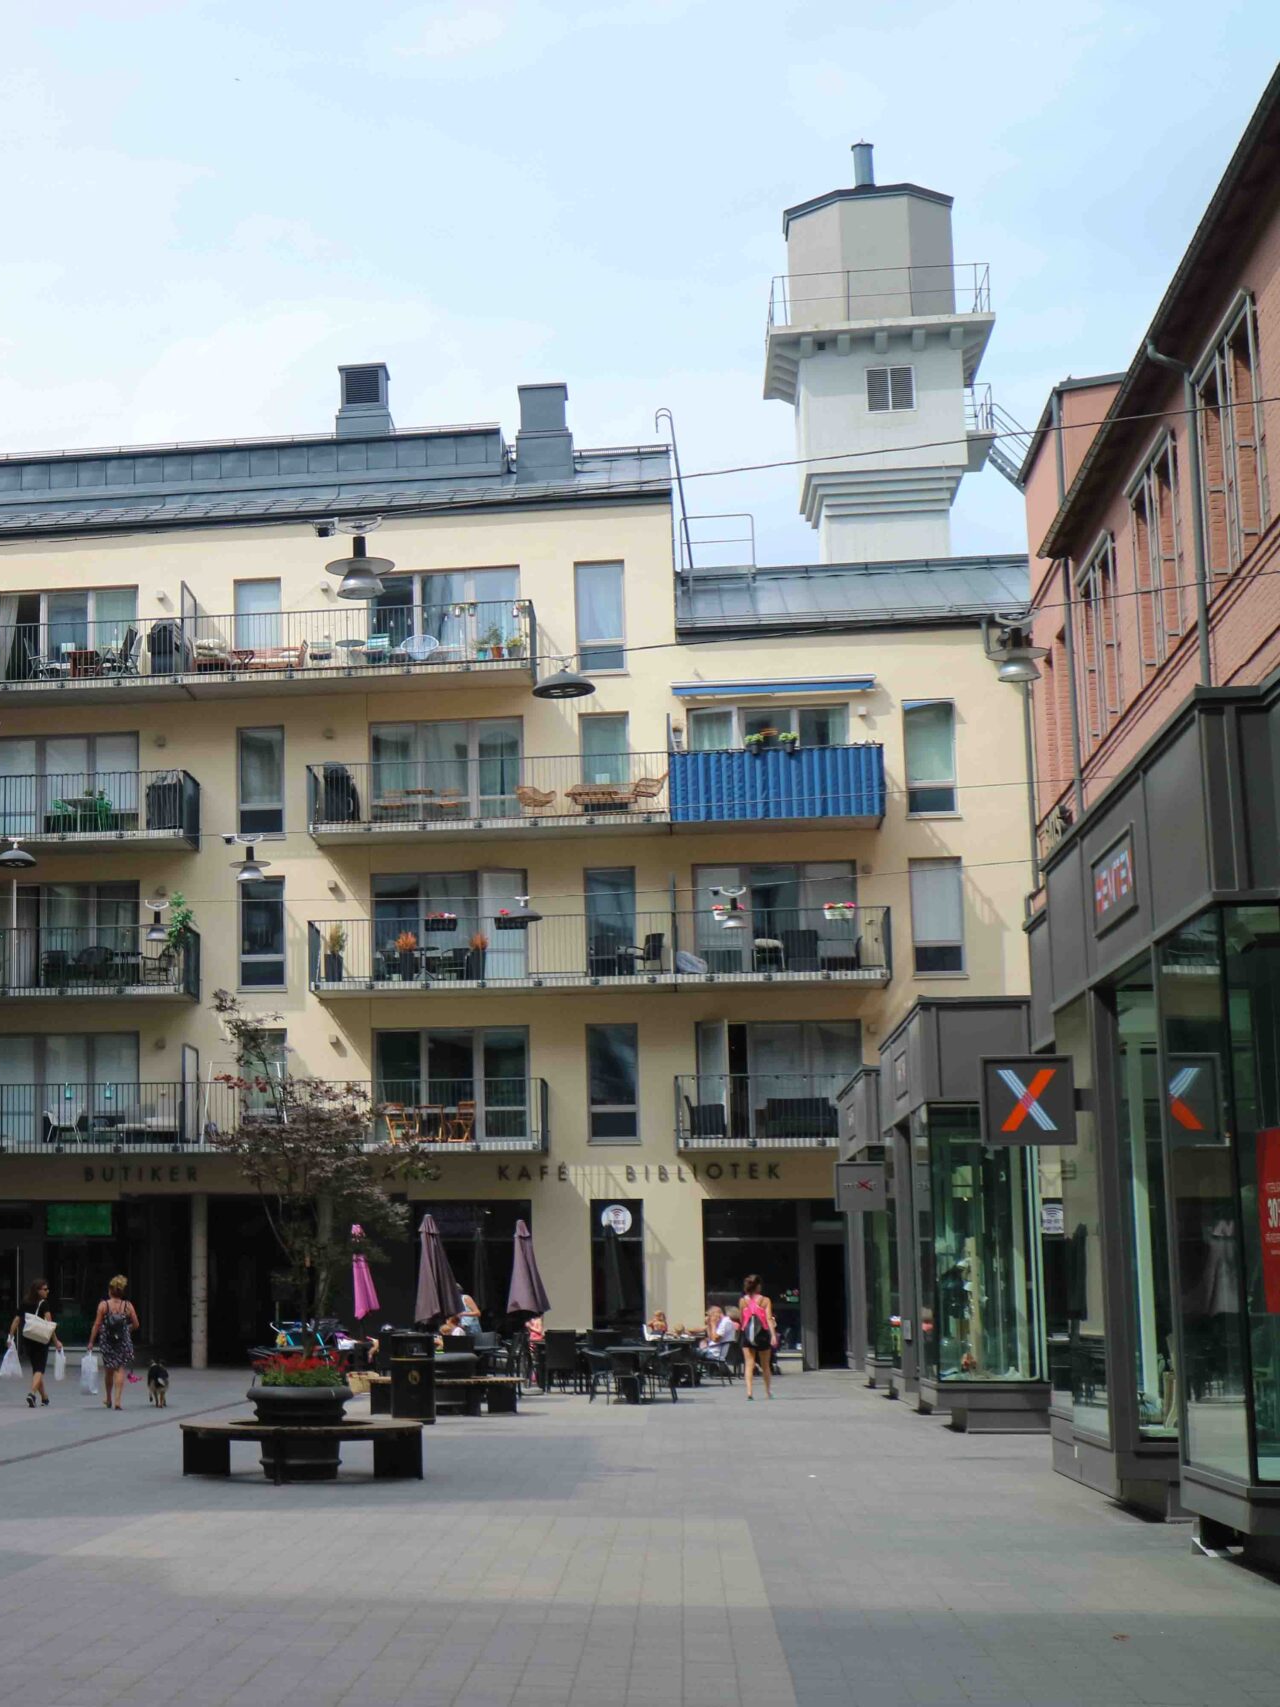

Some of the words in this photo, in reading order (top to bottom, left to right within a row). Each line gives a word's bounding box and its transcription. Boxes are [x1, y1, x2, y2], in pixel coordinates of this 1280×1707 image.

[84, 1166, 198, 1182] BUTIKER
[497, 1161, 568, 1182] KAFÉ
[625, 1162, 781, 1183] BIBLIOTEK
[1267, 1197, 1280, 1229] 30
